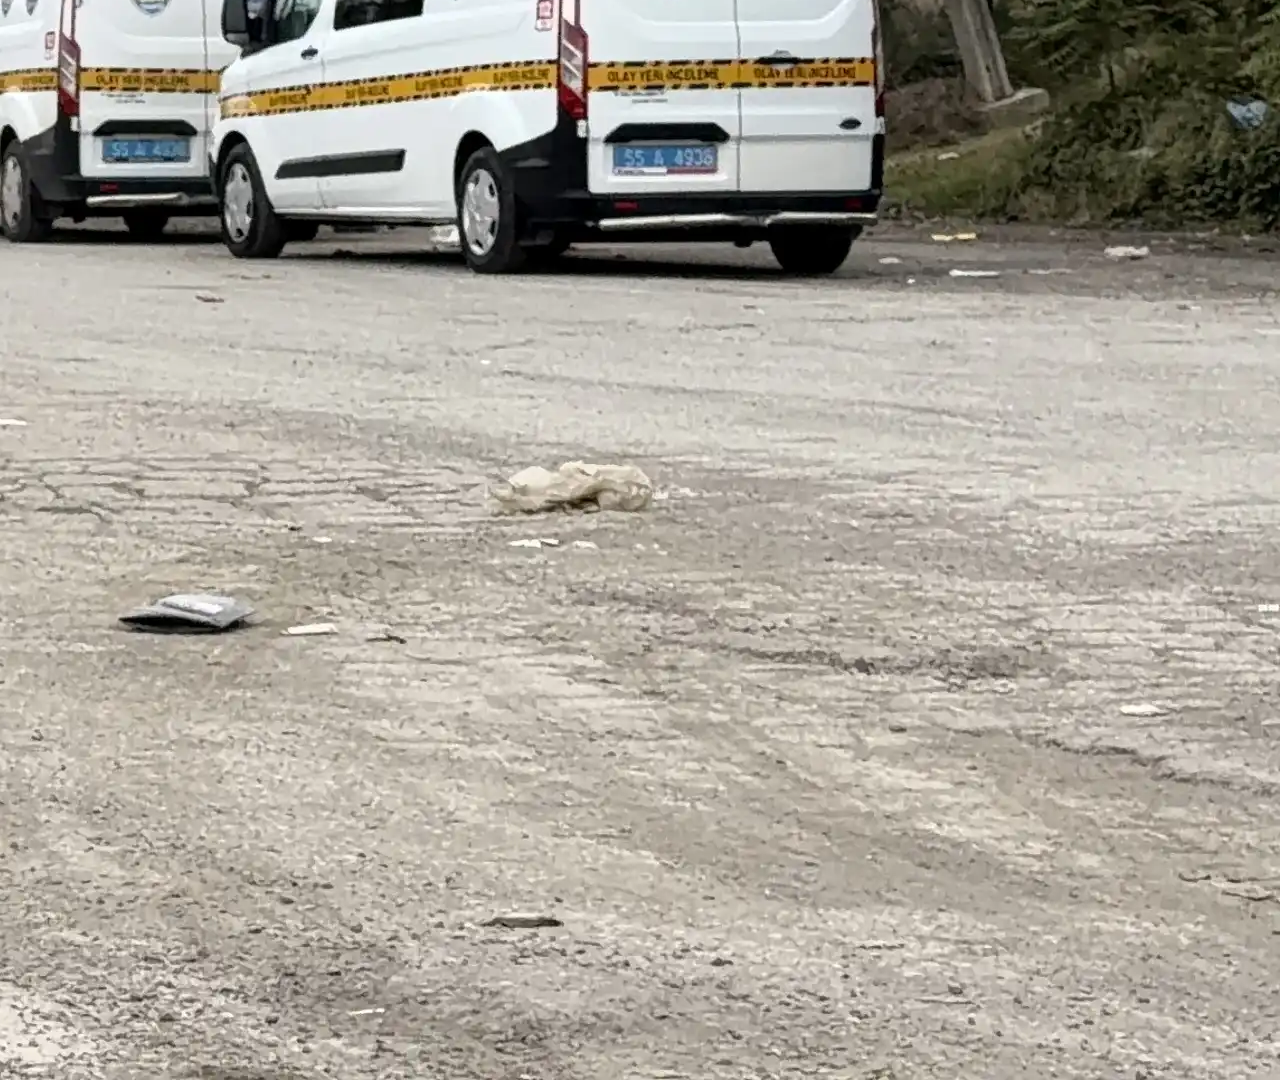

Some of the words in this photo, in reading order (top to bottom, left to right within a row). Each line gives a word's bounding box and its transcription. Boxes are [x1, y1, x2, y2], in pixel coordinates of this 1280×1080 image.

[607, 70, 636, 82] OLAY
[624, 148, 645, 167] 55
[653, 148, 664, 166] A
